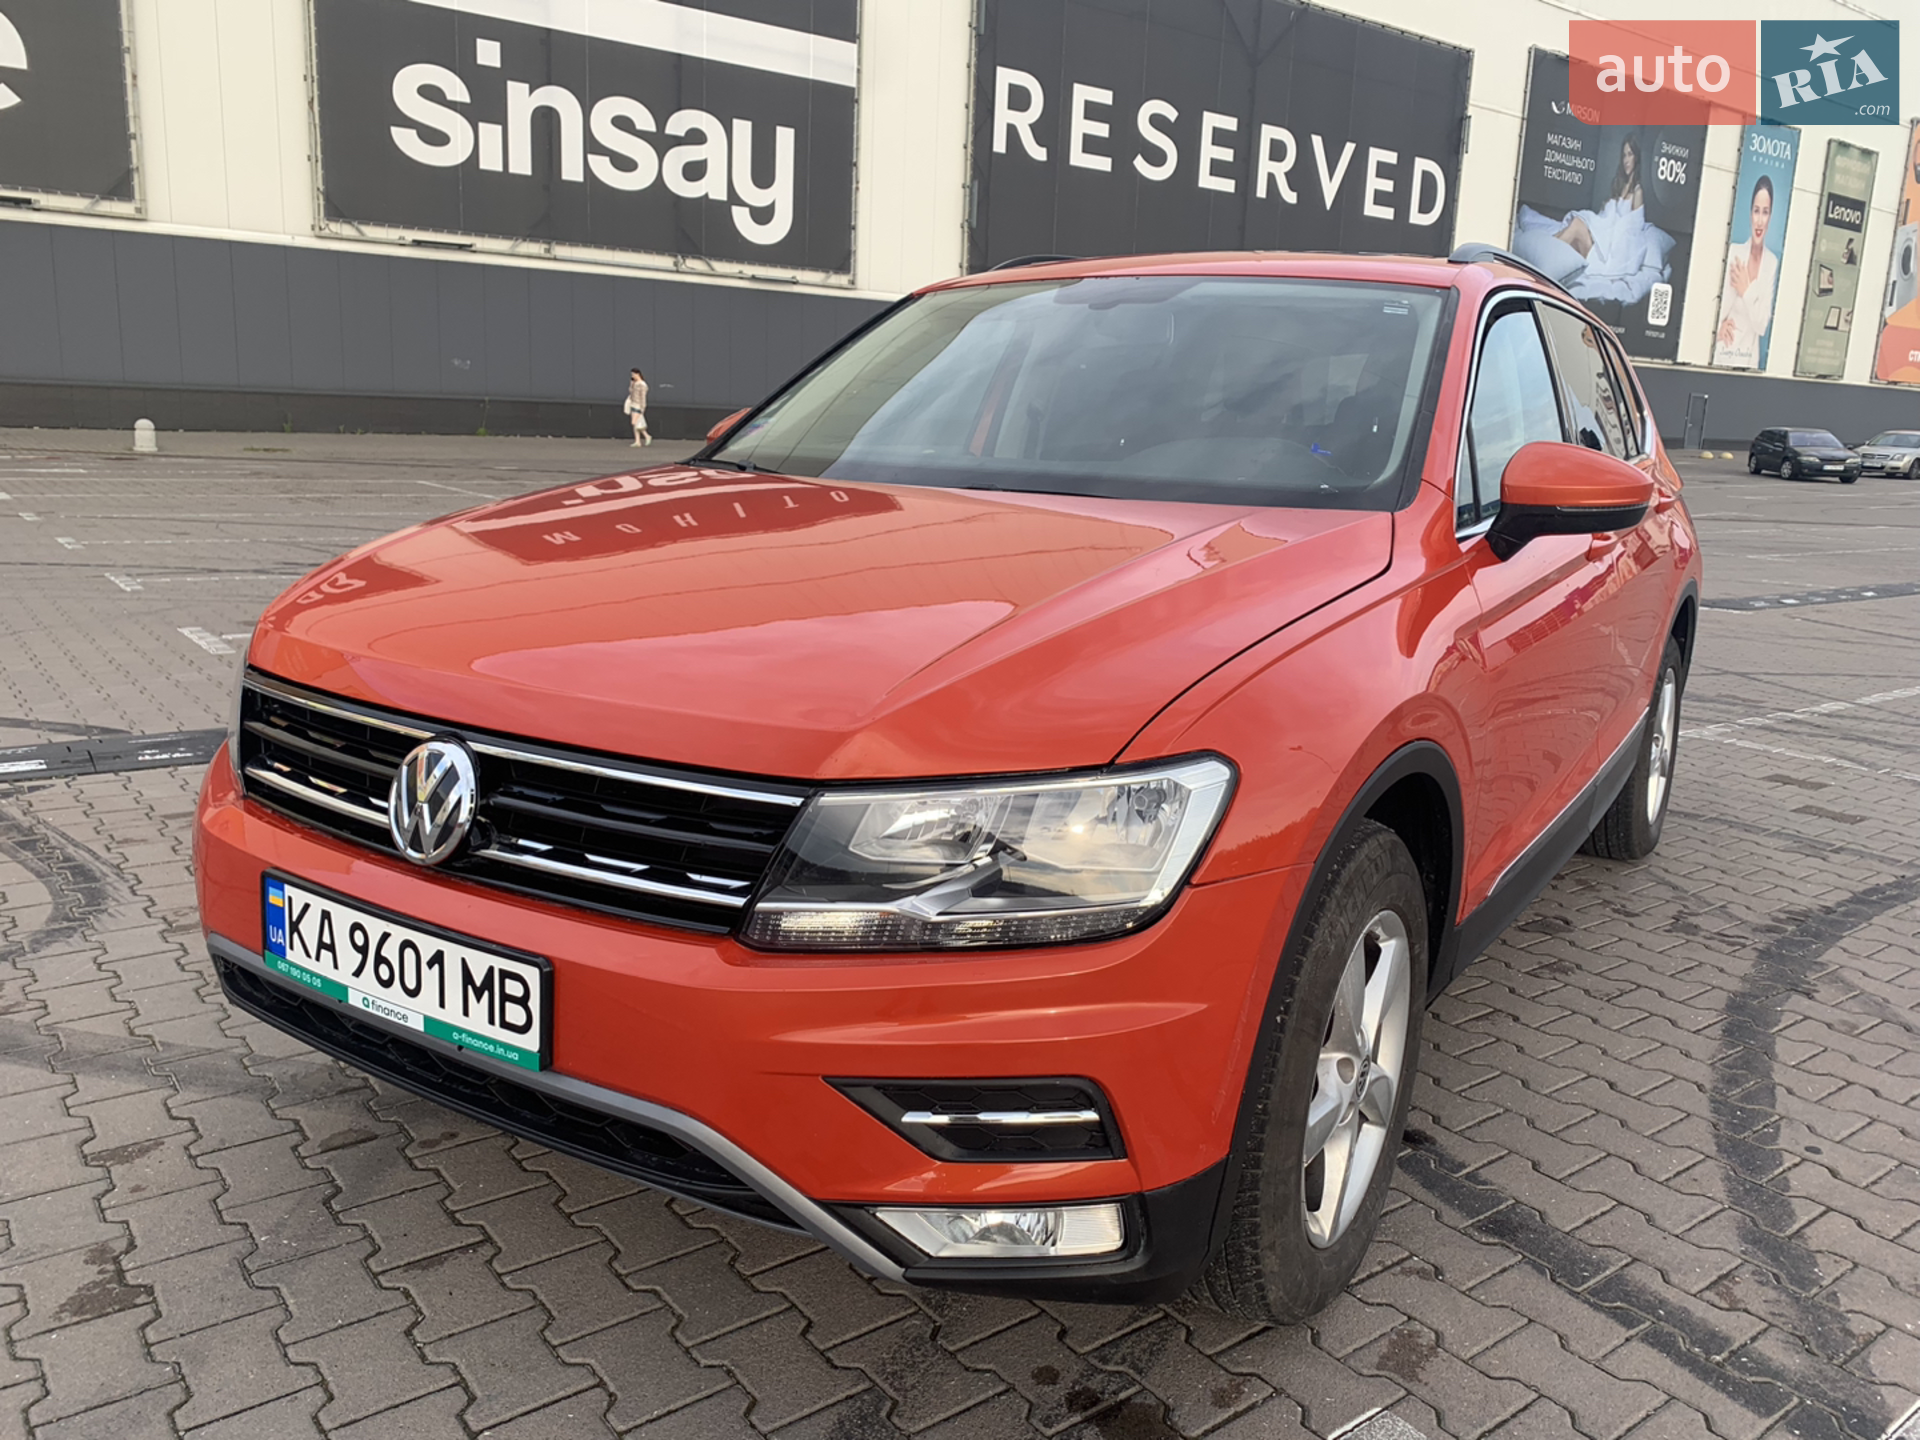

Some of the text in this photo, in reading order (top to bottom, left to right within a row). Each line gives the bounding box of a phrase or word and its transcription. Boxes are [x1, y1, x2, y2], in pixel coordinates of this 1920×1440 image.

[1566, 102, 1600, 123] MIRSON
[391, 38, 795, 245] sinsay
[992, 65, 1446, 226] RESERVED
[1545, 132, 1582, 152] МАГАЗИН
[1660, 141, 1689, 159] ЗНИЖКИ
[1749, 133, 1792, 161] ЗОЛОТА
[1543, 149, 1596, 172] ДОМАШНЬОГО
[1657, 156, 1688, 185] 80%
[1543, 165, 1584, 185] ТЕКСТИЛЮ
[1828, 200, 1862, 224] Lenovo
[268, 924, 285, 947] UA
[288, 895, 533, 1035] KA 9601 MB
[371, 999, 409, 1024] finance
[452, 1031, 519, 1061] a-finance.in.ua
